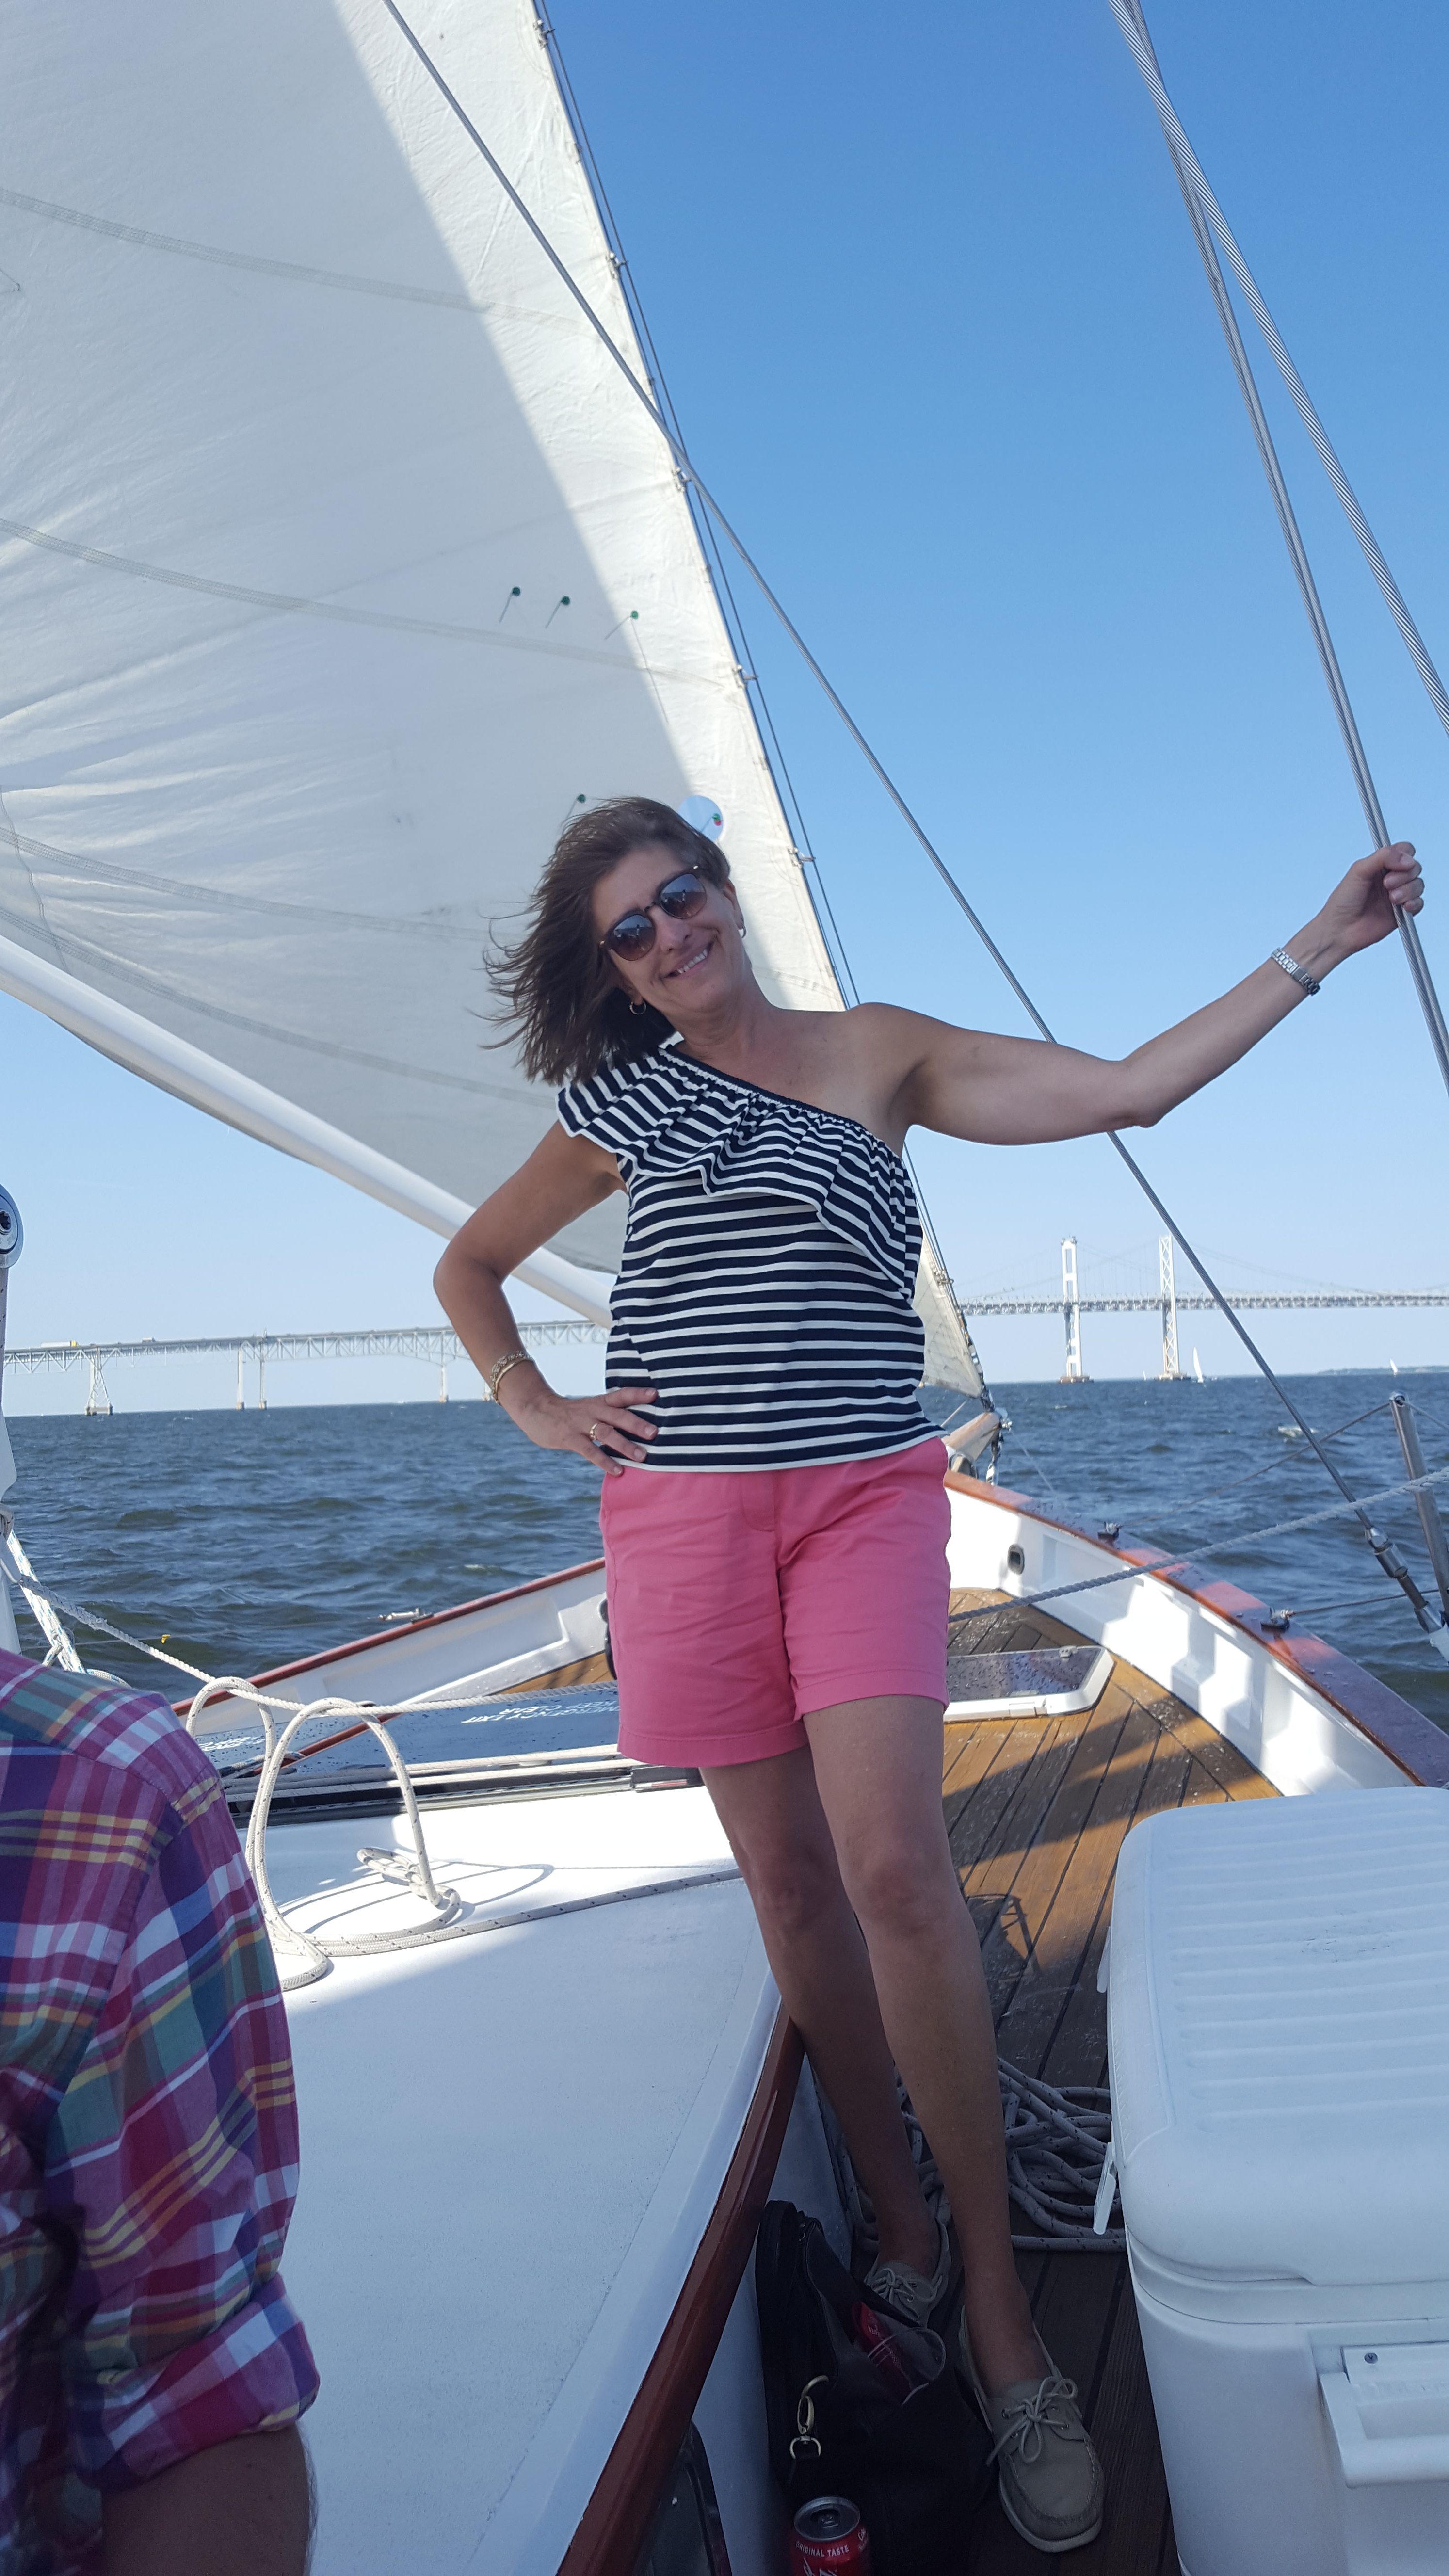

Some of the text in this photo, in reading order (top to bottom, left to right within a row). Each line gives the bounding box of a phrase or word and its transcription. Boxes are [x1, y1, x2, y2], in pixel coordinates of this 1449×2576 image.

[499, 1701, 617, 1715] KEEP CLEAR
[461, 1715, 506, 1723] EXIT
[796, 2541, 849, 2558] ORIGINAL TASTE
